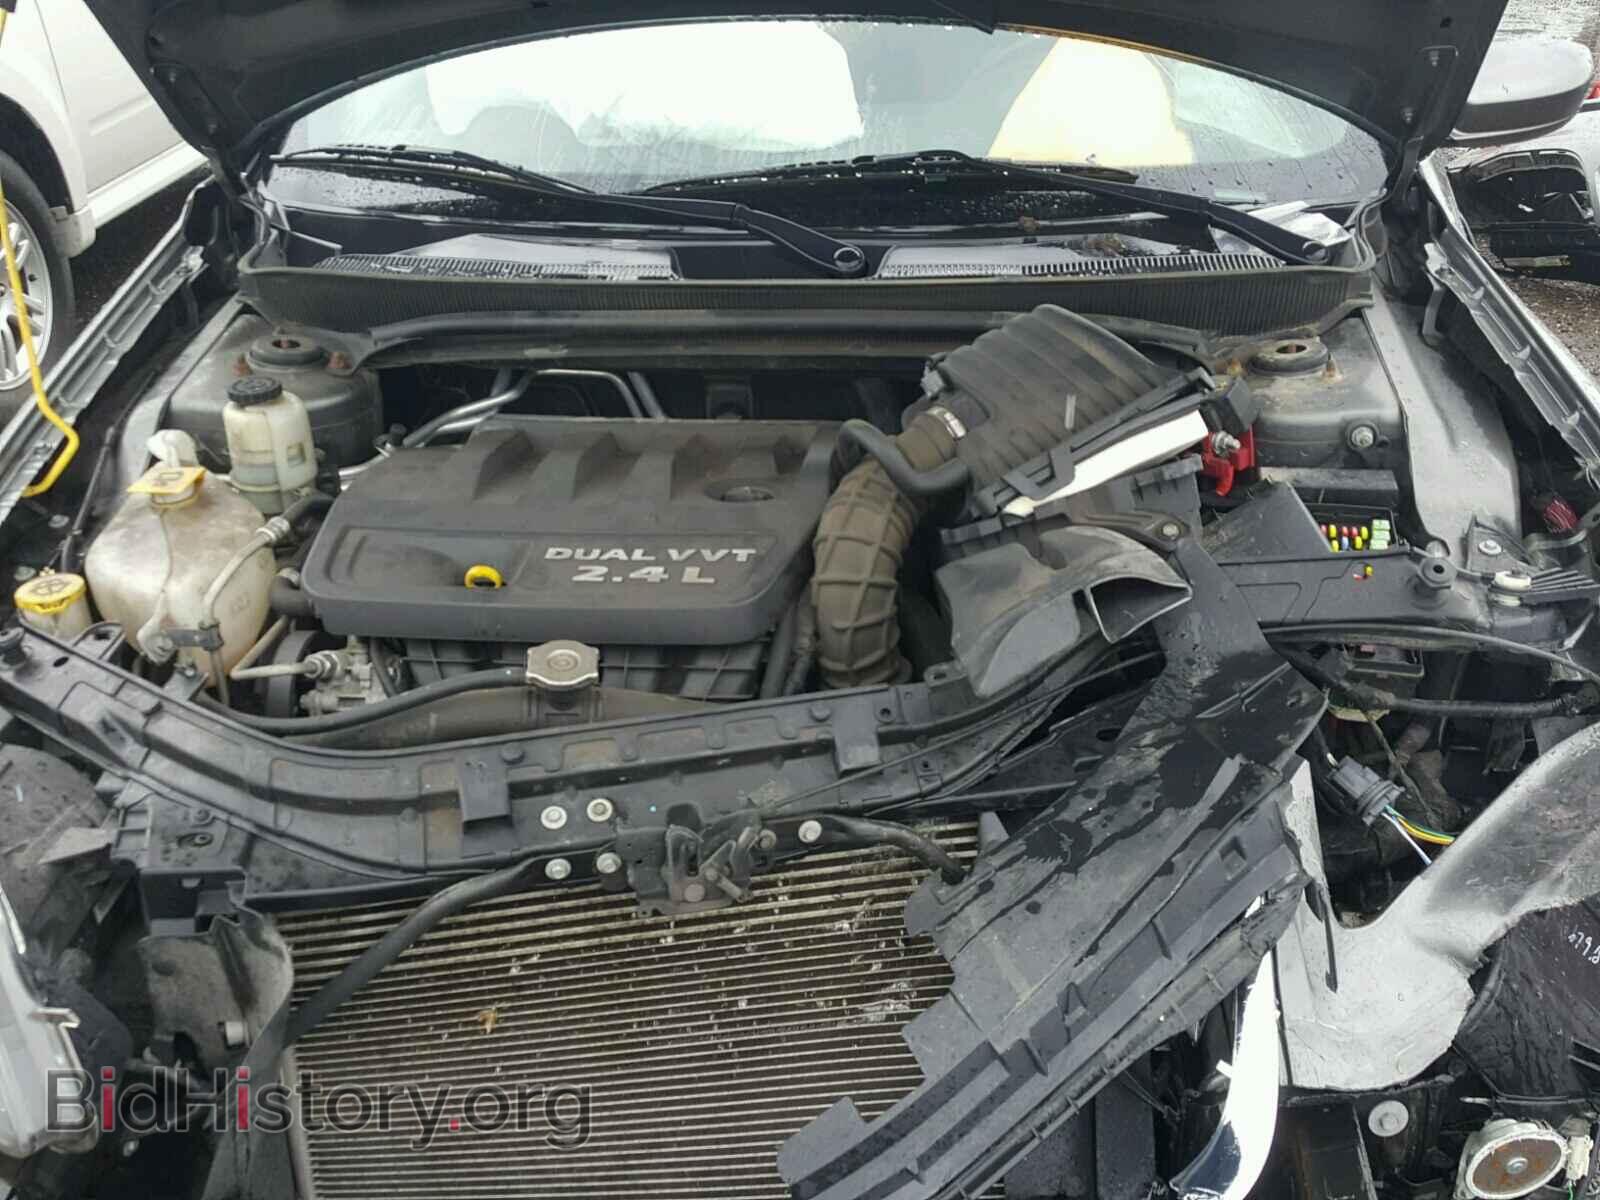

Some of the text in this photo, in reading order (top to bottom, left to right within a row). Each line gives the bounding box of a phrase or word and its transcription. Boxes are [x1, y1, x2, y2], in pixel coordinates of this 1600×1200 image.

[544, 547, 757, 562] DUAL VVT
[572, 565, 715, 583] 2.4 L
